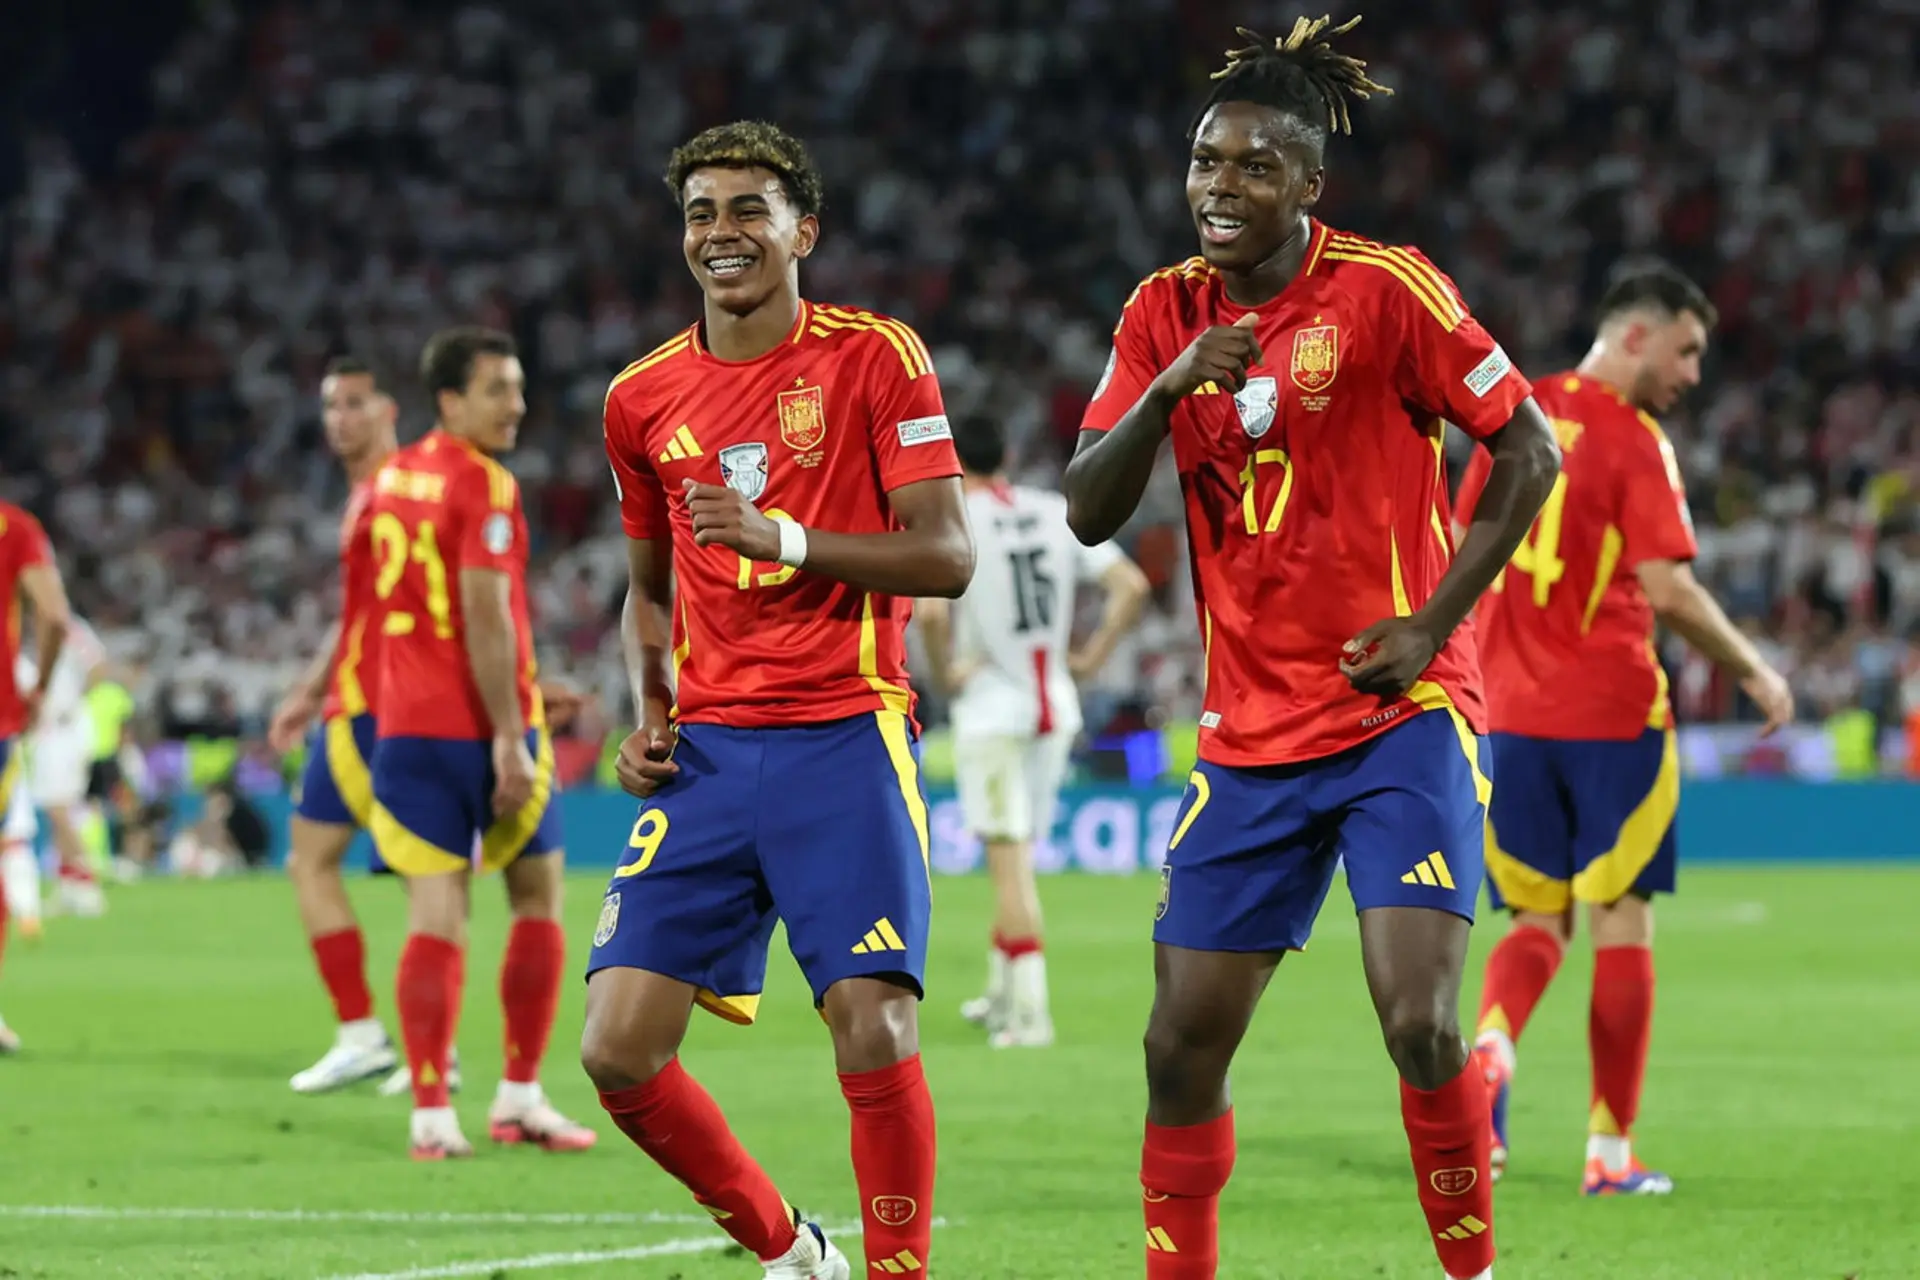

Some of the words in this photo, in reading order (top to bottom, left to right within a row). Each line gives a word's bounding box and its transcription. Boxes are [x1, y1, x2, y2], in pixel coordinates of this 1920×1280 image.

[1239, 449, 1293, 534] 17
[371, 512, 454, 640] 21
[1492, 470, 1568, 608] 4
[1008, 546, 1055, 632] 15
[614, 807, 669, 878] 9
[1169, 769, 1210, 851] 7
